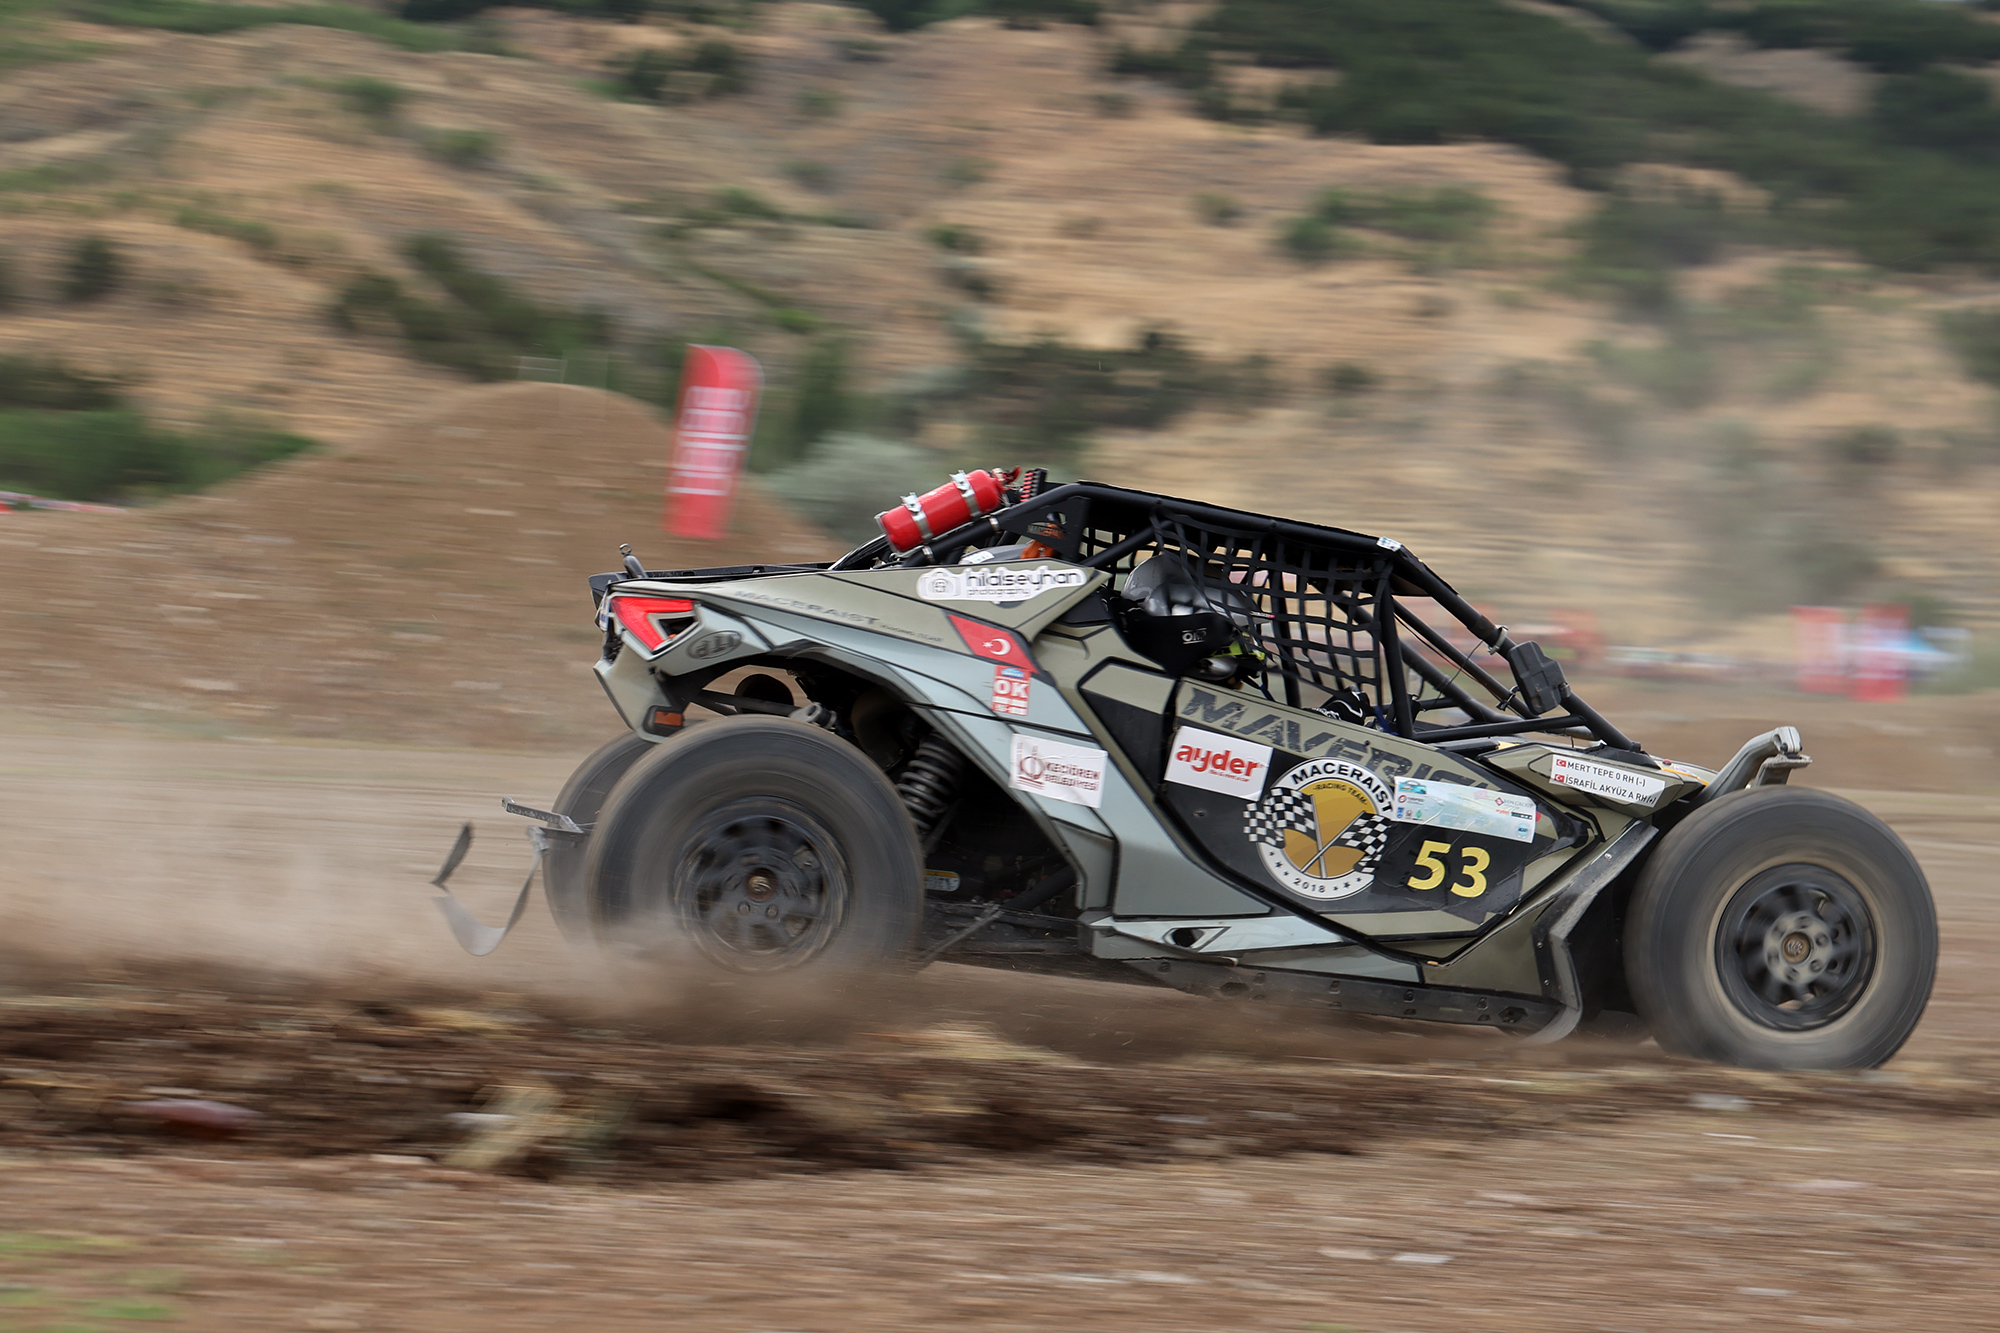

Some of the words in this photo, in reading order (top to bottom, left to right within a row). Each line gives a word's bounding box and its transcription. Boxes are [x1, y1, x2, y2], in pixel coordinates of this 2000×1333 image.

[993, 680, 1029, 698] OK
[1176, 745, 1259, 776] ayder
[1567, 761, 1591, 773] MERT
[1593, 767, 1614, 779] TEPE
[1622, 774, 1634, 784] RH
[1291, 762, 1394, 813] MACERAIST
[1565, 774, 1597, 790] İSRAFİL
[1599, 783, 1627, 797] AKYÜZ
[1628, 791, 1634, 799] A
[1407, 840, 1490, 898] 53
[1293, 877, 1326, 893] 2018
